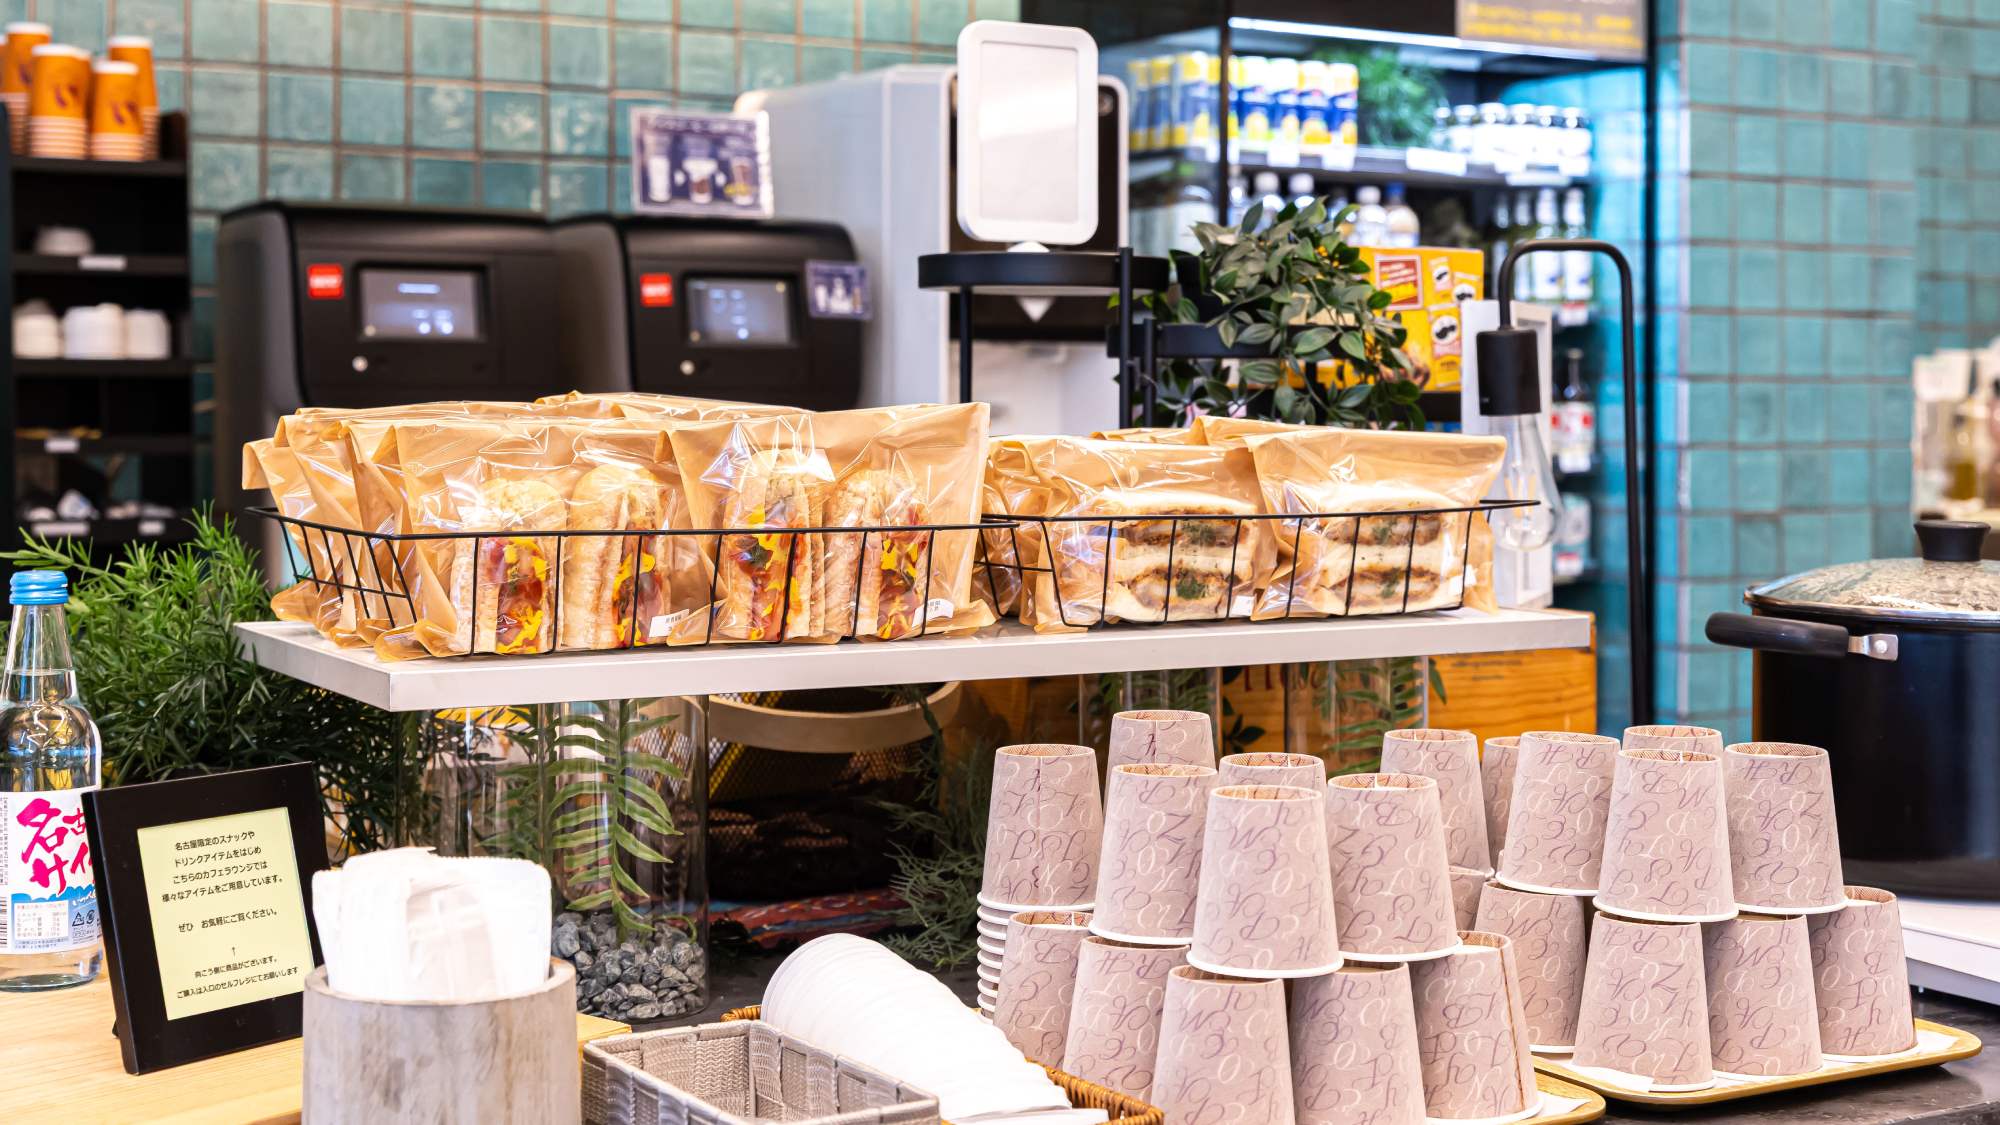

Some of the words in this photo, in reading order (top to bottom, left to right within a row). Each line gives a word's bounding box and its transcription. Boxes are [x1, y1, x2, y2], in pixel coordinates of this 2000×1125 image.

[175, 831, 255, 851] 名古屋限定のスナックや
[29, 842, 95, 895] サイ
[174, 846, 261, 868] ドリンクアイテムをはじめ
[173, 861, 268, 884] こちらのカフェラウンジでは
[162, 874, 283, 902] 様々なアイテムをご用意しています。
[178, 922, 194, 932] ぜひ
[201, 908, 278, 929] お気軽にご覧ください。
